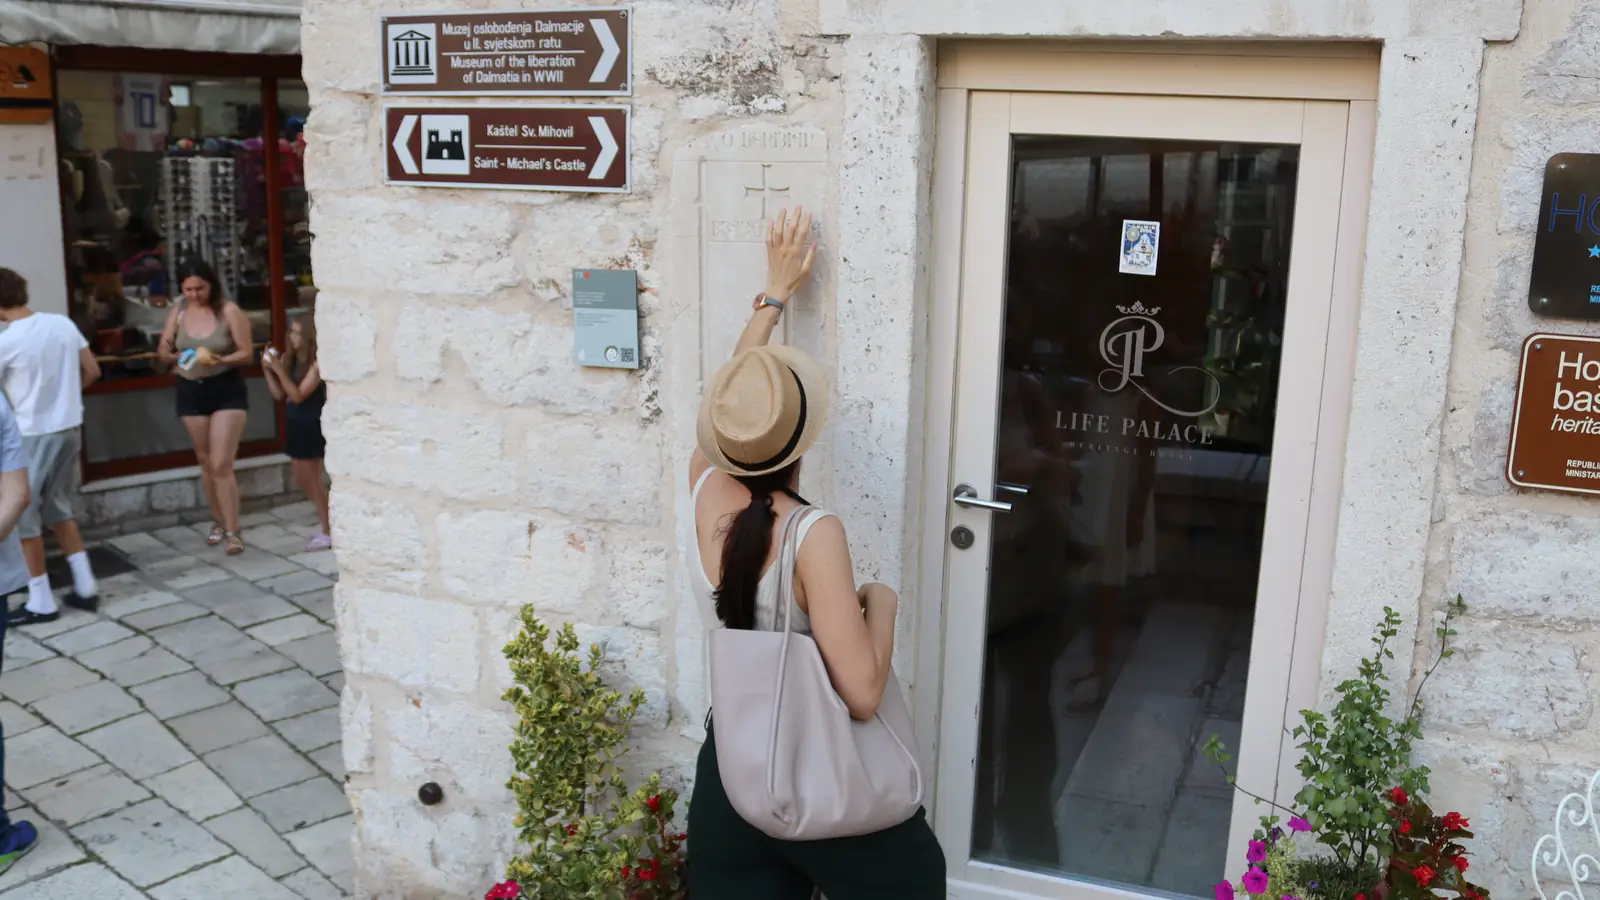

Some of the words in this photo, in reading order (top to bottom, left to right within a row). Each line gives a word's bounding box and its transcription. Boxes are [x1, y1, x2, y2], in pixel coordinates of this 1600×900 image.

[442, 22, 470, 37] Muzej
[473, 21, 532, 36] oslobođenja
[535, 20, 585, 35] Dalmacije
[464, 40, 471, 49] u
[472, 39, 482, 49] II.
[484, 37, 536, 52] svjetskom
[539, 37, 562, 48] ratu
[451, 56, 493, 69] Museum
[495, 55, 507, 68] of
[508, 55, 525, 67] the
[527, 54, 575, 67] liberation
[463, 71, 473, 83] of
[476, 70, 520, 83] Dalmatia
[522, 71, 530, 82] in
[534, 70, 563, 82] WWII
[486, 123, 518, 137] Kaštel
[521, 125, 536, 137] Sv.
[538, 125, 574, 138] Mihovil
[474, 156, 498, 169] Saint
[507, 157, 551, 170] Michael's
[553, 158, 586, 171] Castle
[1557, 351, 1600, 381] Ho
[1055, 410, 1110, 434] LIFE
[1121, 417, 1214, 445] PALACE
